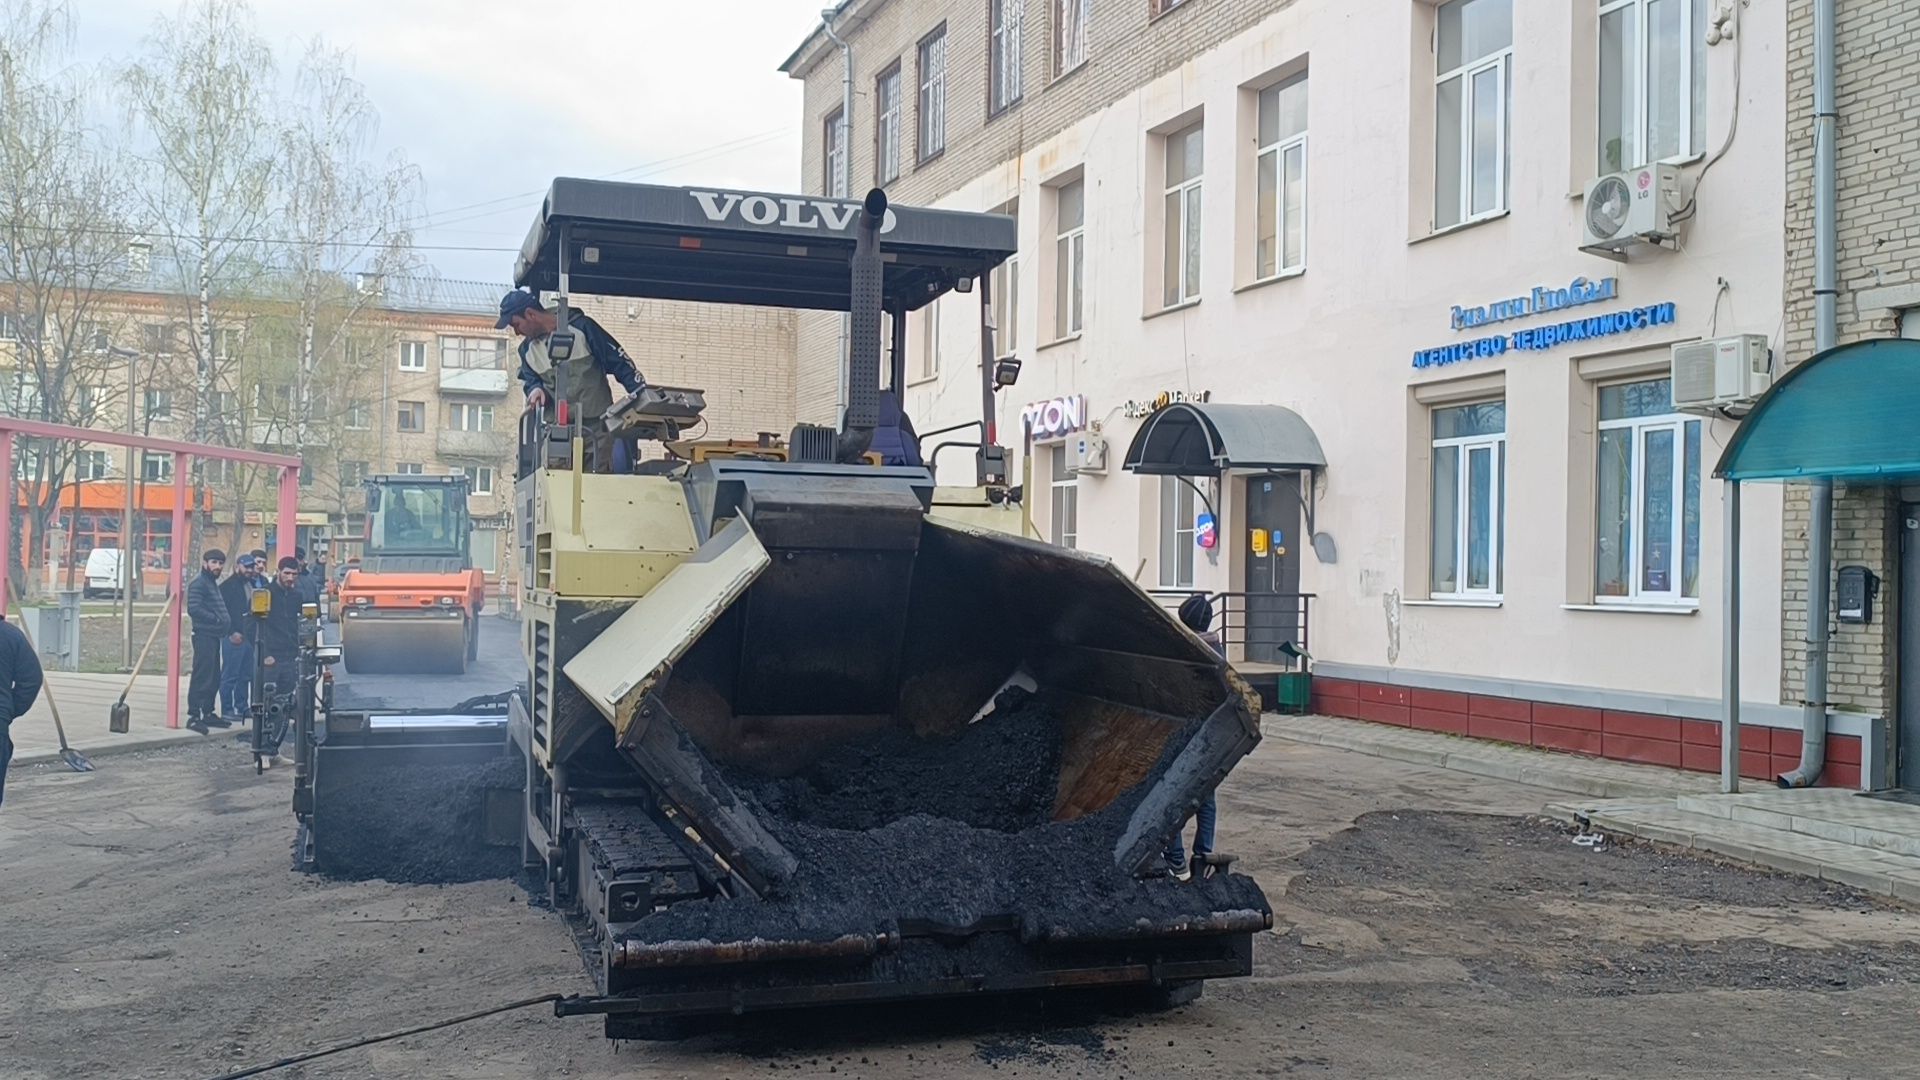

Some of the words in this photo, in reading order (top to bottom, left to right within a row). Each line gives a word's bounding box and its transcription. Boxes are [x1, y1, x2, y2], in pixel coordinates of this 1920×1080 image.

[1637, 189, 1649, 200] LG
[1411, 335, 1508, 370] АГЕНТСТВО
[1508, 302, 1677, 351] НЕДВИЖИМОСТИ
[1019, 396, 1083, 435] OZON
